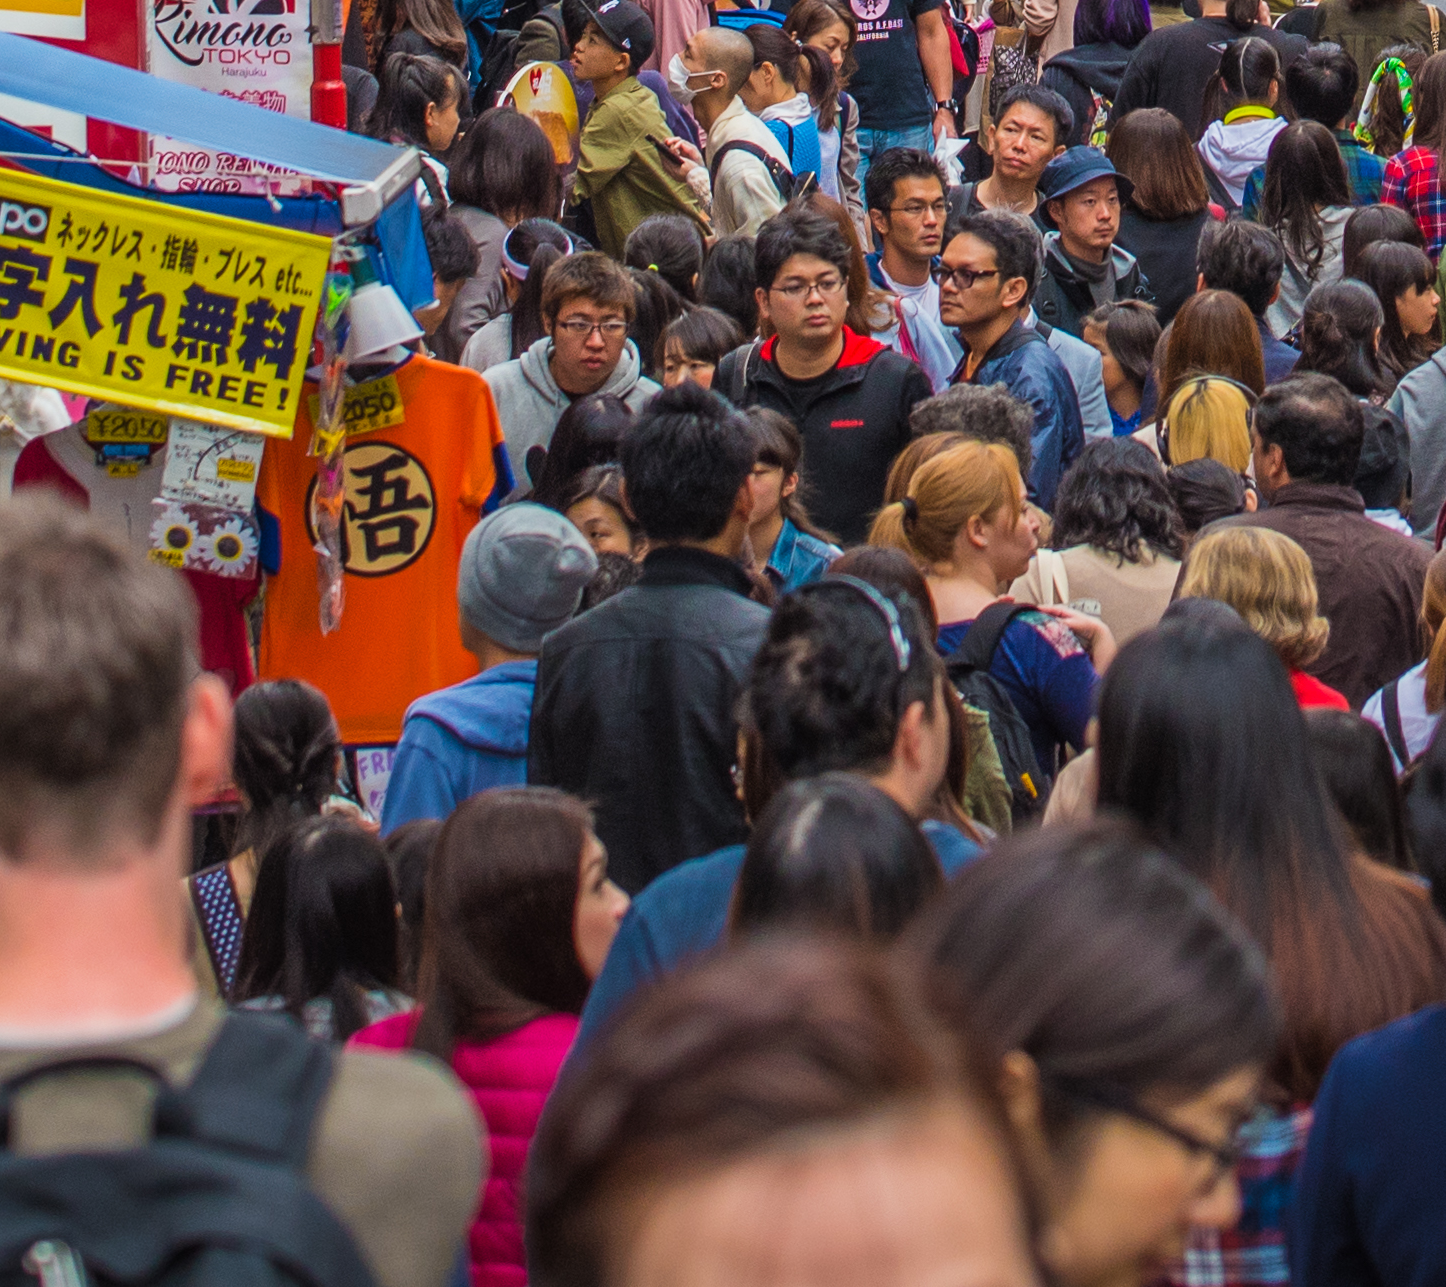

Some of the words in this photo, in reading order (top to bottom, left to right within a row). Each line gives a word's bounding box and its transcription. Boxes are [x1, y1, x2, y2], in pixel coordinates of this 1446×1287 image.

[202, 46, 291, 65] TOKYO
[221, 66, 267, 78] Harajuku
[102, 348, 144, 383] IS
[165, 363, 290, 413] FREE!
